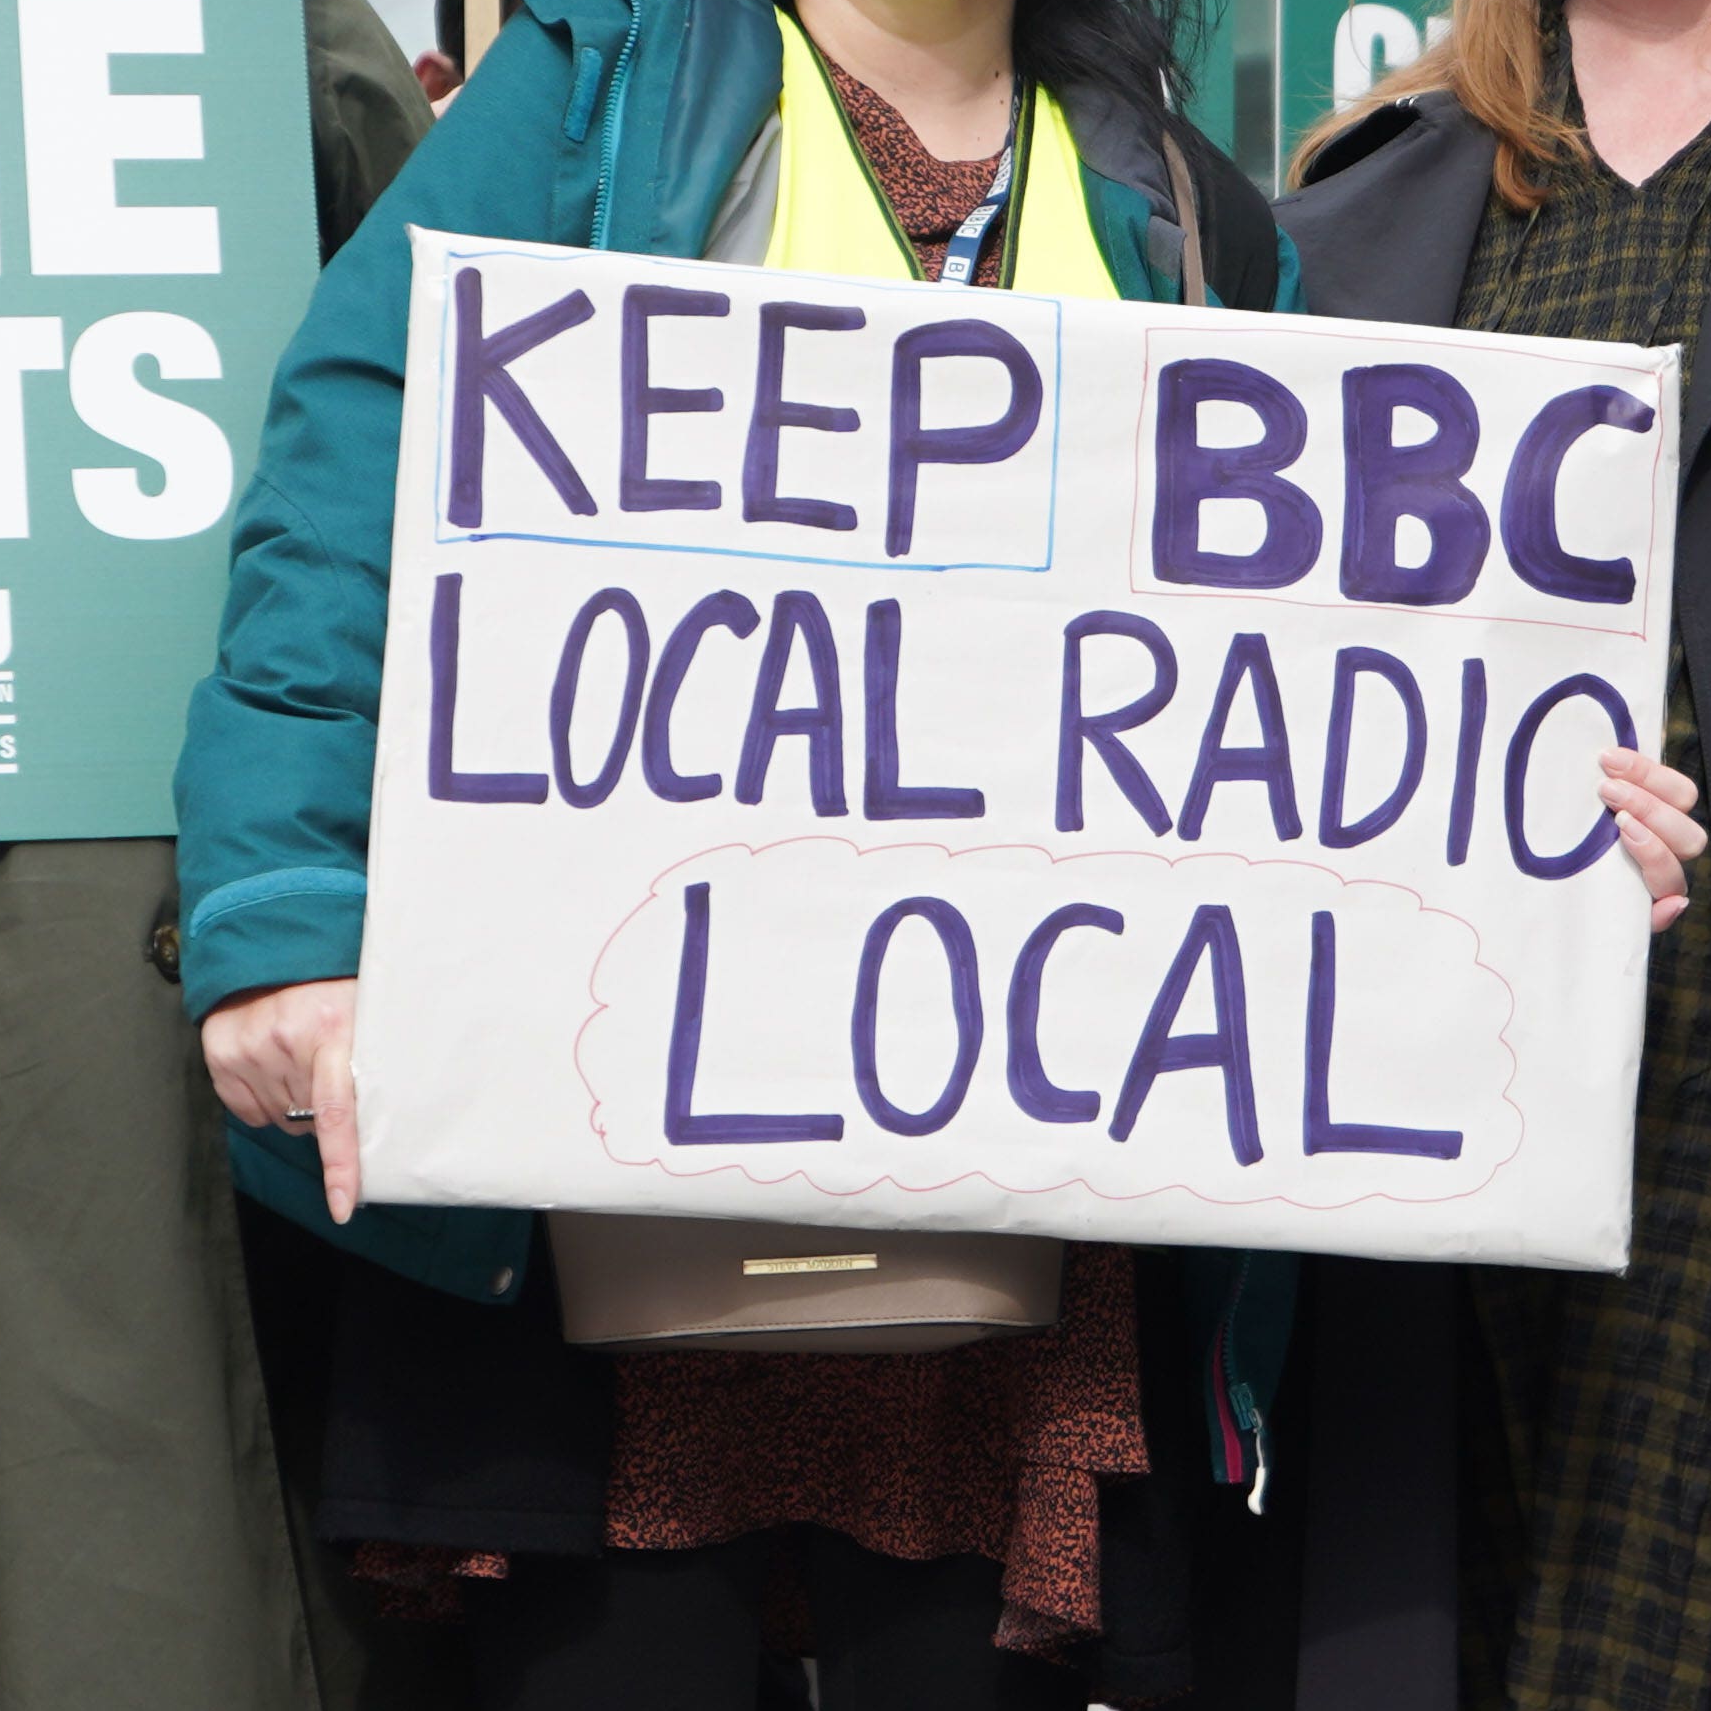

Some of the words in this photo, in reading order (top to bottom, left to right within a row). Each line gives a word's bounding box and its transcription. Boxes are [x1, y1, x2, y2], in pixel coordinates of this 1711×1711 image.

[447, 266, 1043, 558] KEEP
[1151, 357, 1655, 606] BBC
[428, 572, 986, 822] LOCAL
[1054, 609, 1635, 881] RADIO
[664, 881, 1463, 1166] LOCAL
